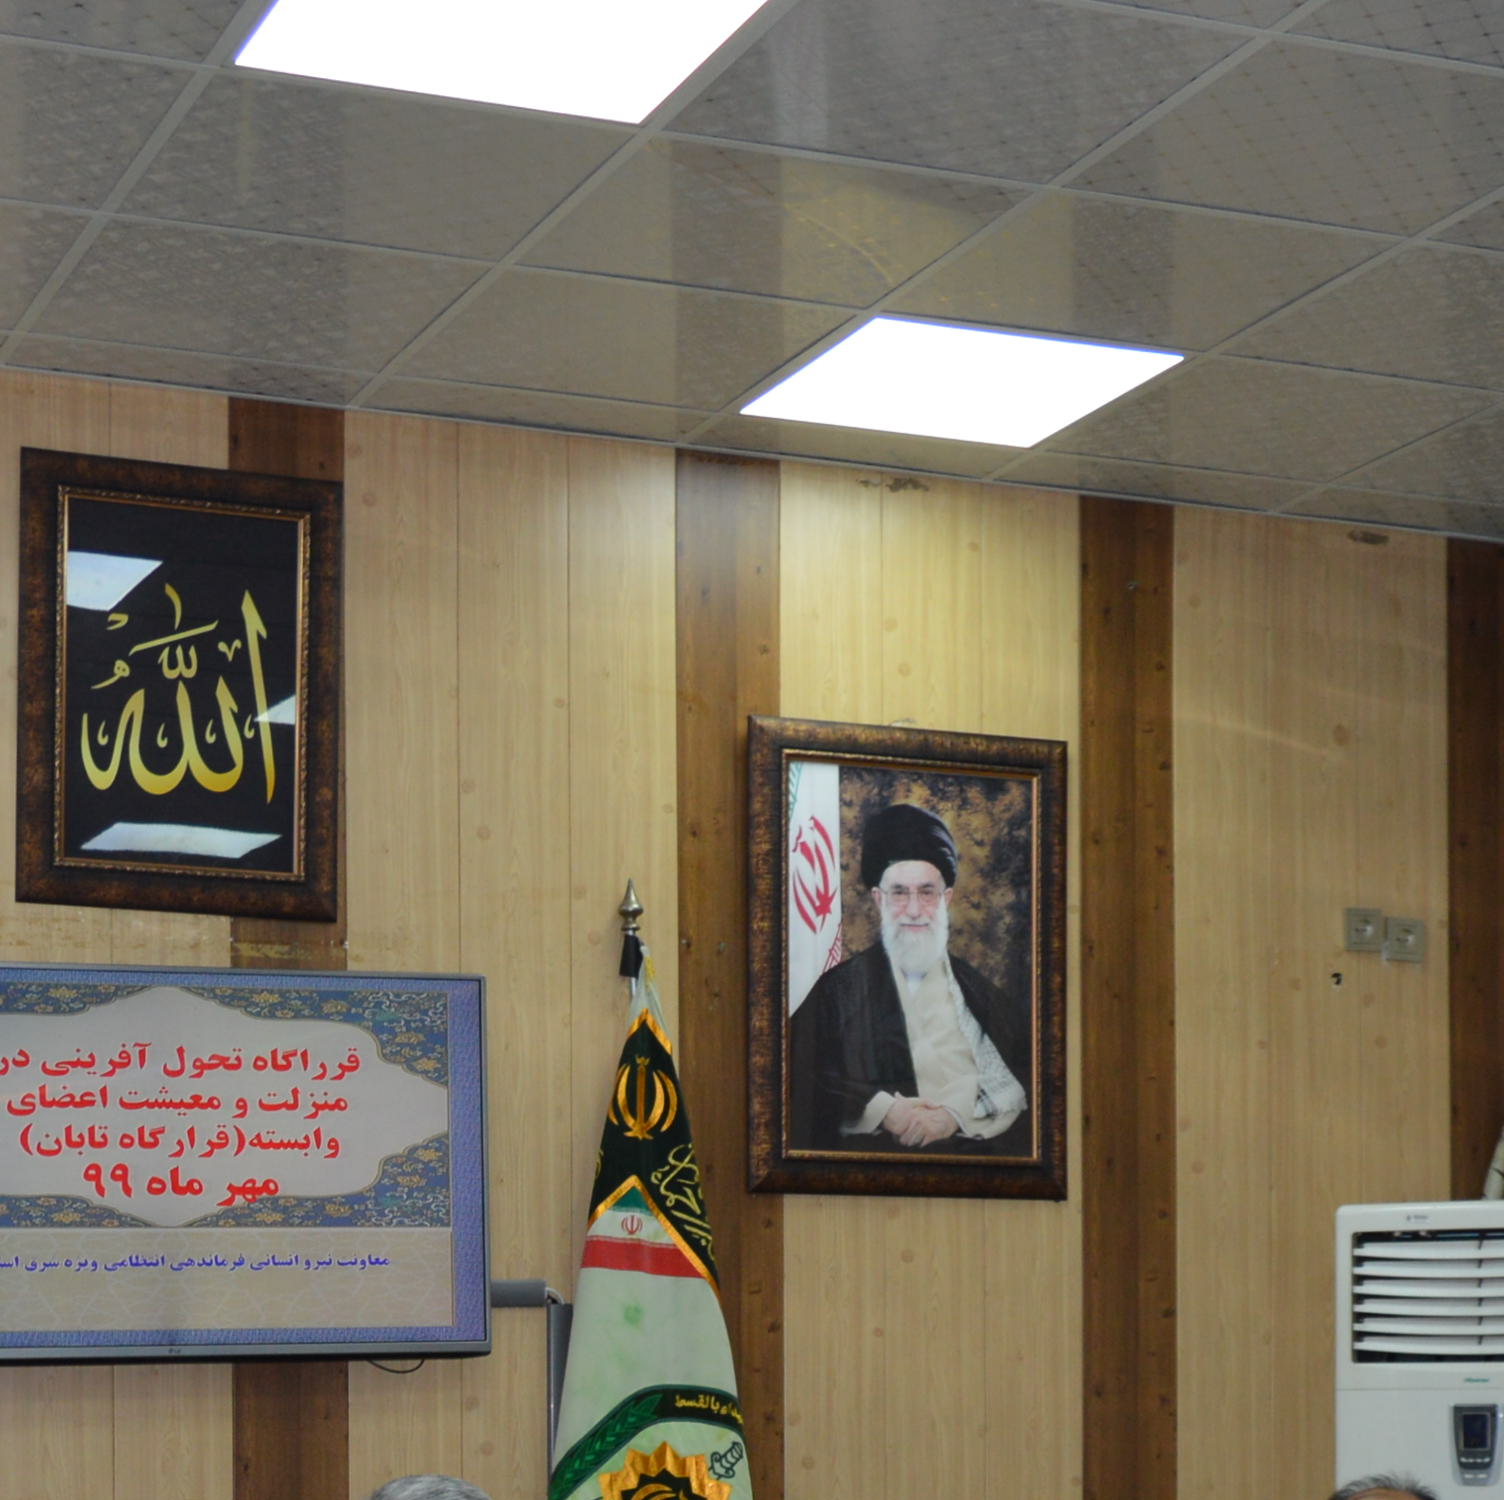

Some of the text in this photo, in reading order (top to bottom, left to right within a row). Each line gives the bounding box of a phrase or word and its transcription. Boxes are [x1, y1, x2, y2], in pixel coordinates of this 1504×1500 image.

[40, 1042, 152, 1078] آفرینی
[163, 1046, 243, 1079] تحول
[6, 1084, 349, 1120] منزلت و معیشت اعضای
[83, 1162, 281, 1207] مهر ماه ۹۹
